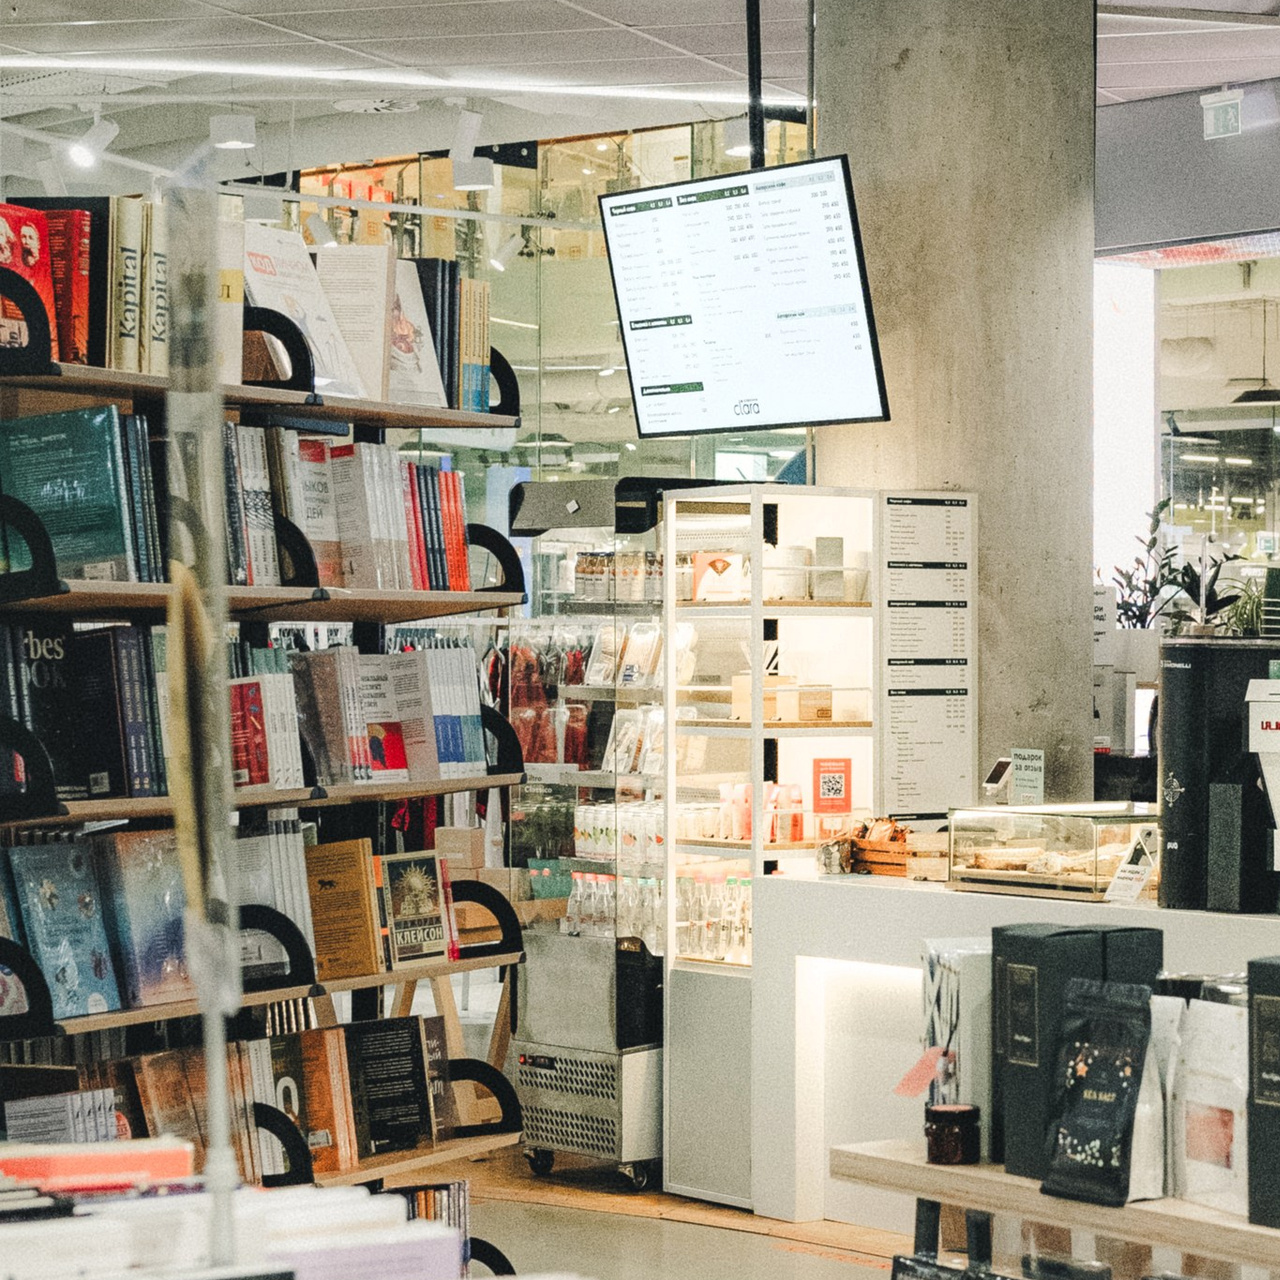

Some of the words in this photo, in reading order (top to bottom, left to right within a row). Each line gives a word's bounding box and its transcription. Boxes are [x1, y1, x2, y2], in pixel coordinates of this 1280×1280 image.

[119, 246, 138, 339] Kapital
[152, 252, 169, 342] Kapital
[734, 400, 760, 416] clara
[395, 926, 443, 945] КЛЕЙСОН
